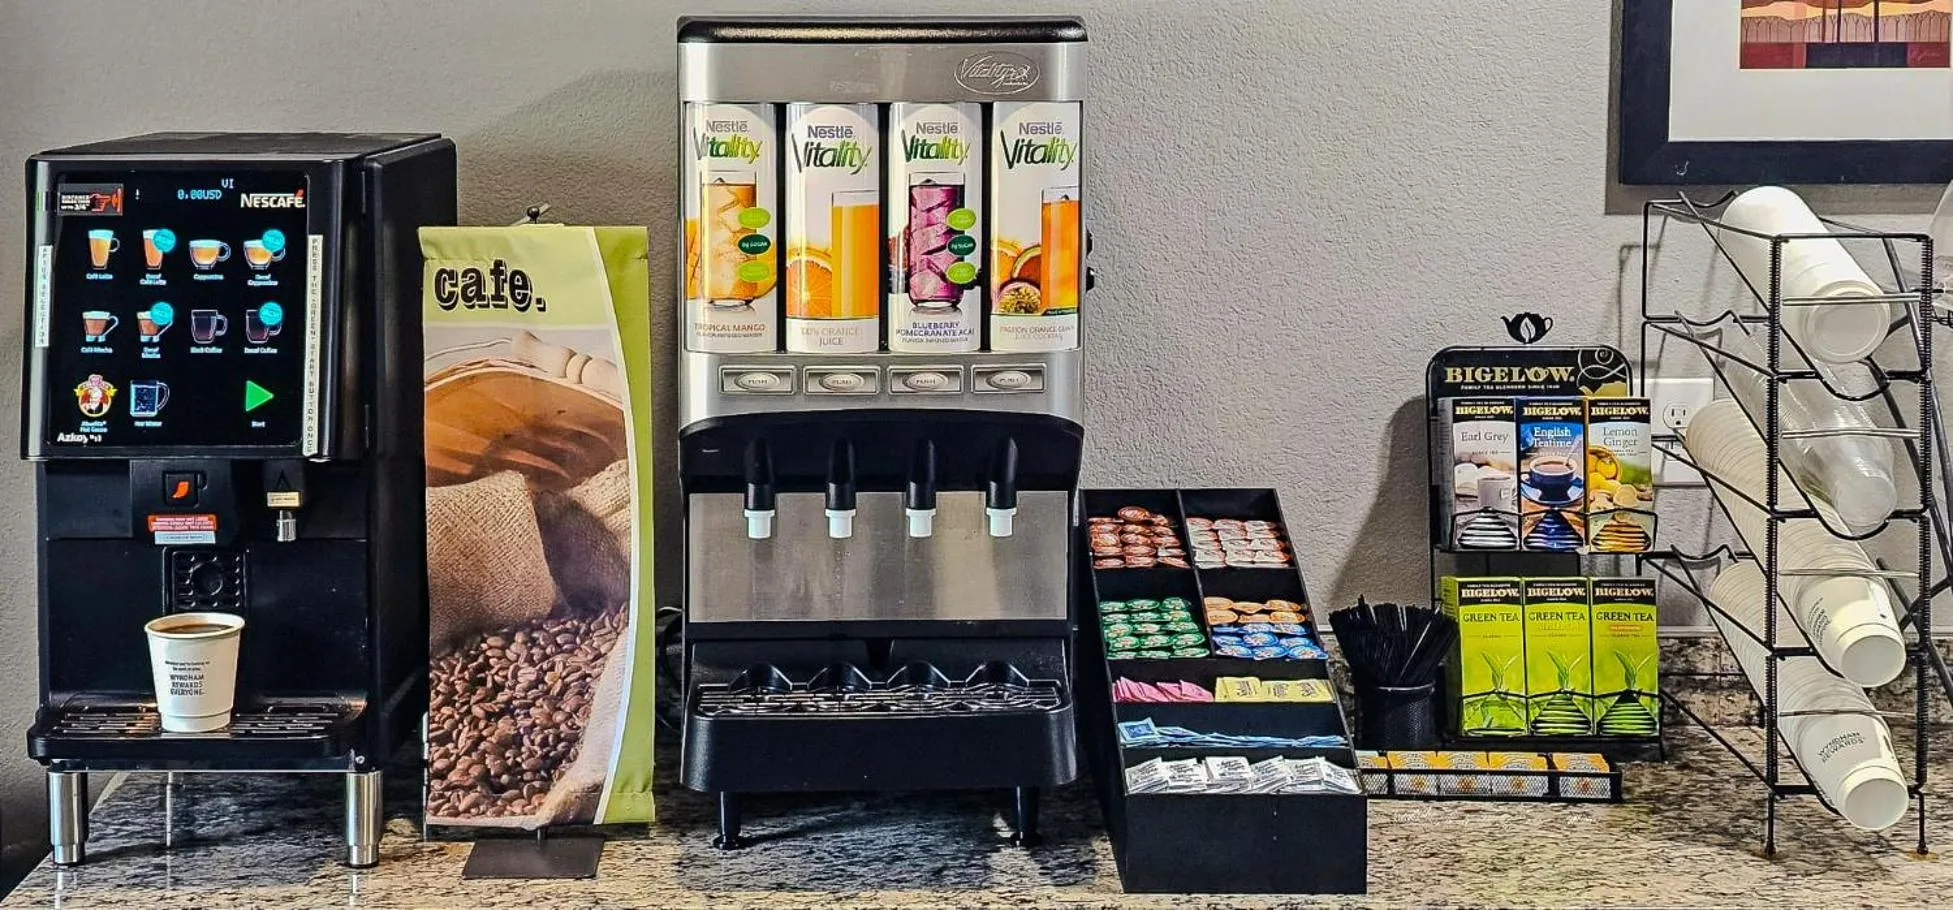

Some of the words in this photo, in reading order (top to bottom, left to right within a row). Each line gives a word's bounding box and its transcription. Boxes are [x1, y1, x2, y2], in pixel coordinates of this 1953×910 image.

[912, 321, 960, 330] BLUEBERRY
[819, 336, 843, 346] JUICE
[1534, 427, 1571, 439] English
[1603, 427, 1638, 436] Lemon
[1461, 431, 1481, 442] Earl
[1484, 431, 1509, 444] Grey
[1534, 438, 1571, 447] Teatime
[1603, 437, 1637, 449] Ginger
[1463, 612, 1497, 622] GREEN
[1499, 612, 1520, 621] TEA
[1529, 612, 1563, 621] GREEN
[1565, 612, 1585, 621] TEA
[1596, 612, 1630, 621] GREEN
[1632, 612, 1654, 621] TEA
